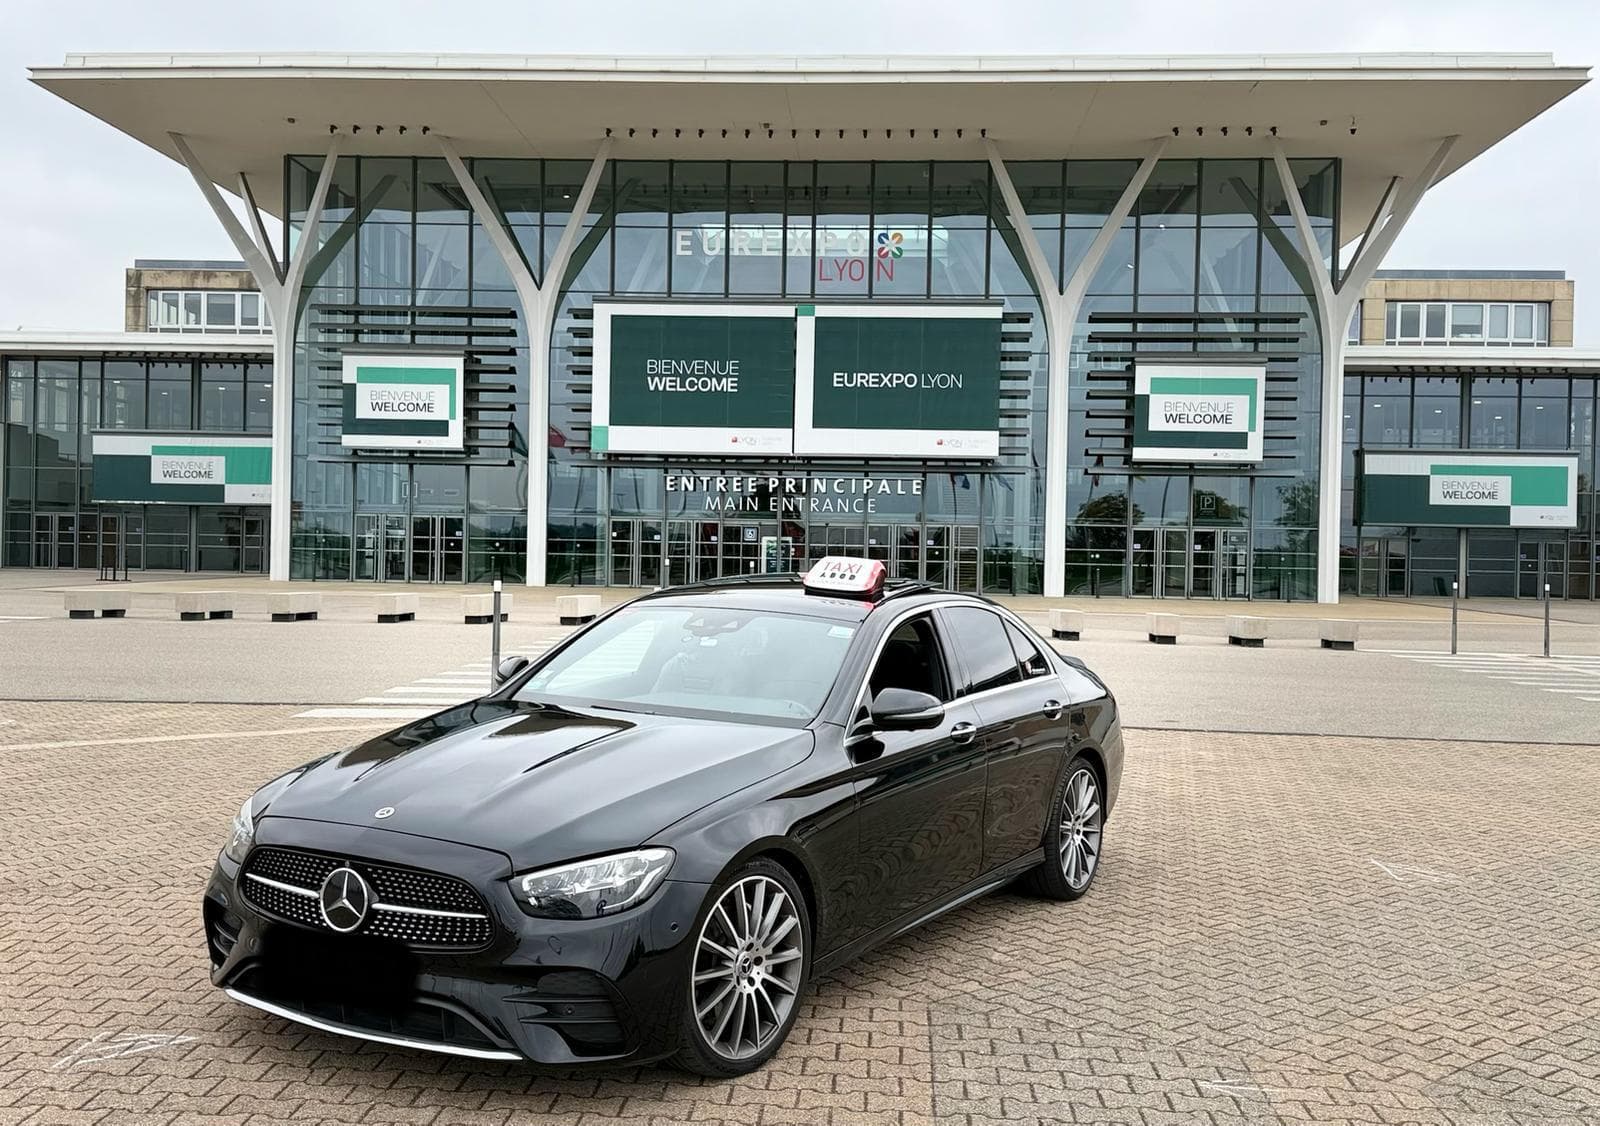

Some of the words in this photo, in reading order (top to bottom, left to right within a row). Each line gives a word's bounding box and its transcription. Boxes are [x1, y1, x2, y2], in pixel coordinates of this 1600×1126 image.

[675, 230, 866, 257] EUREXPO
[819, 259, 895, 282] LYON
[646, 359, 740, 376] BIENVENUE
[647, 376, 738, 393] WELCOME
[832, 372, 918, 388] EUREXPO
[921, 373, 963, 389] LYON
[370, 390, 436, 402] BIENVENUE
[370, 402, 435, 413] WELCOME
[1163, 401, 1235, 414] BIENVENUE
[1164, 413, 1233, 425] WELCOME
[161, 460, 214, 471] BIENVENUE
[162, 470, 214, 479] WELCOME
[665, 476, 758, 493] ENTREE
[768, 478, 923, 495] PRINCIPALE
[1441, 480, 1500, 491] BIENVENUE
[1442, 490, 1499, 500] WELCOME
[705, 495, 760, 512] MAIN
[769, 497, 877, 513] ENTRANCE
[824, 561, 864, 574] TAXI
